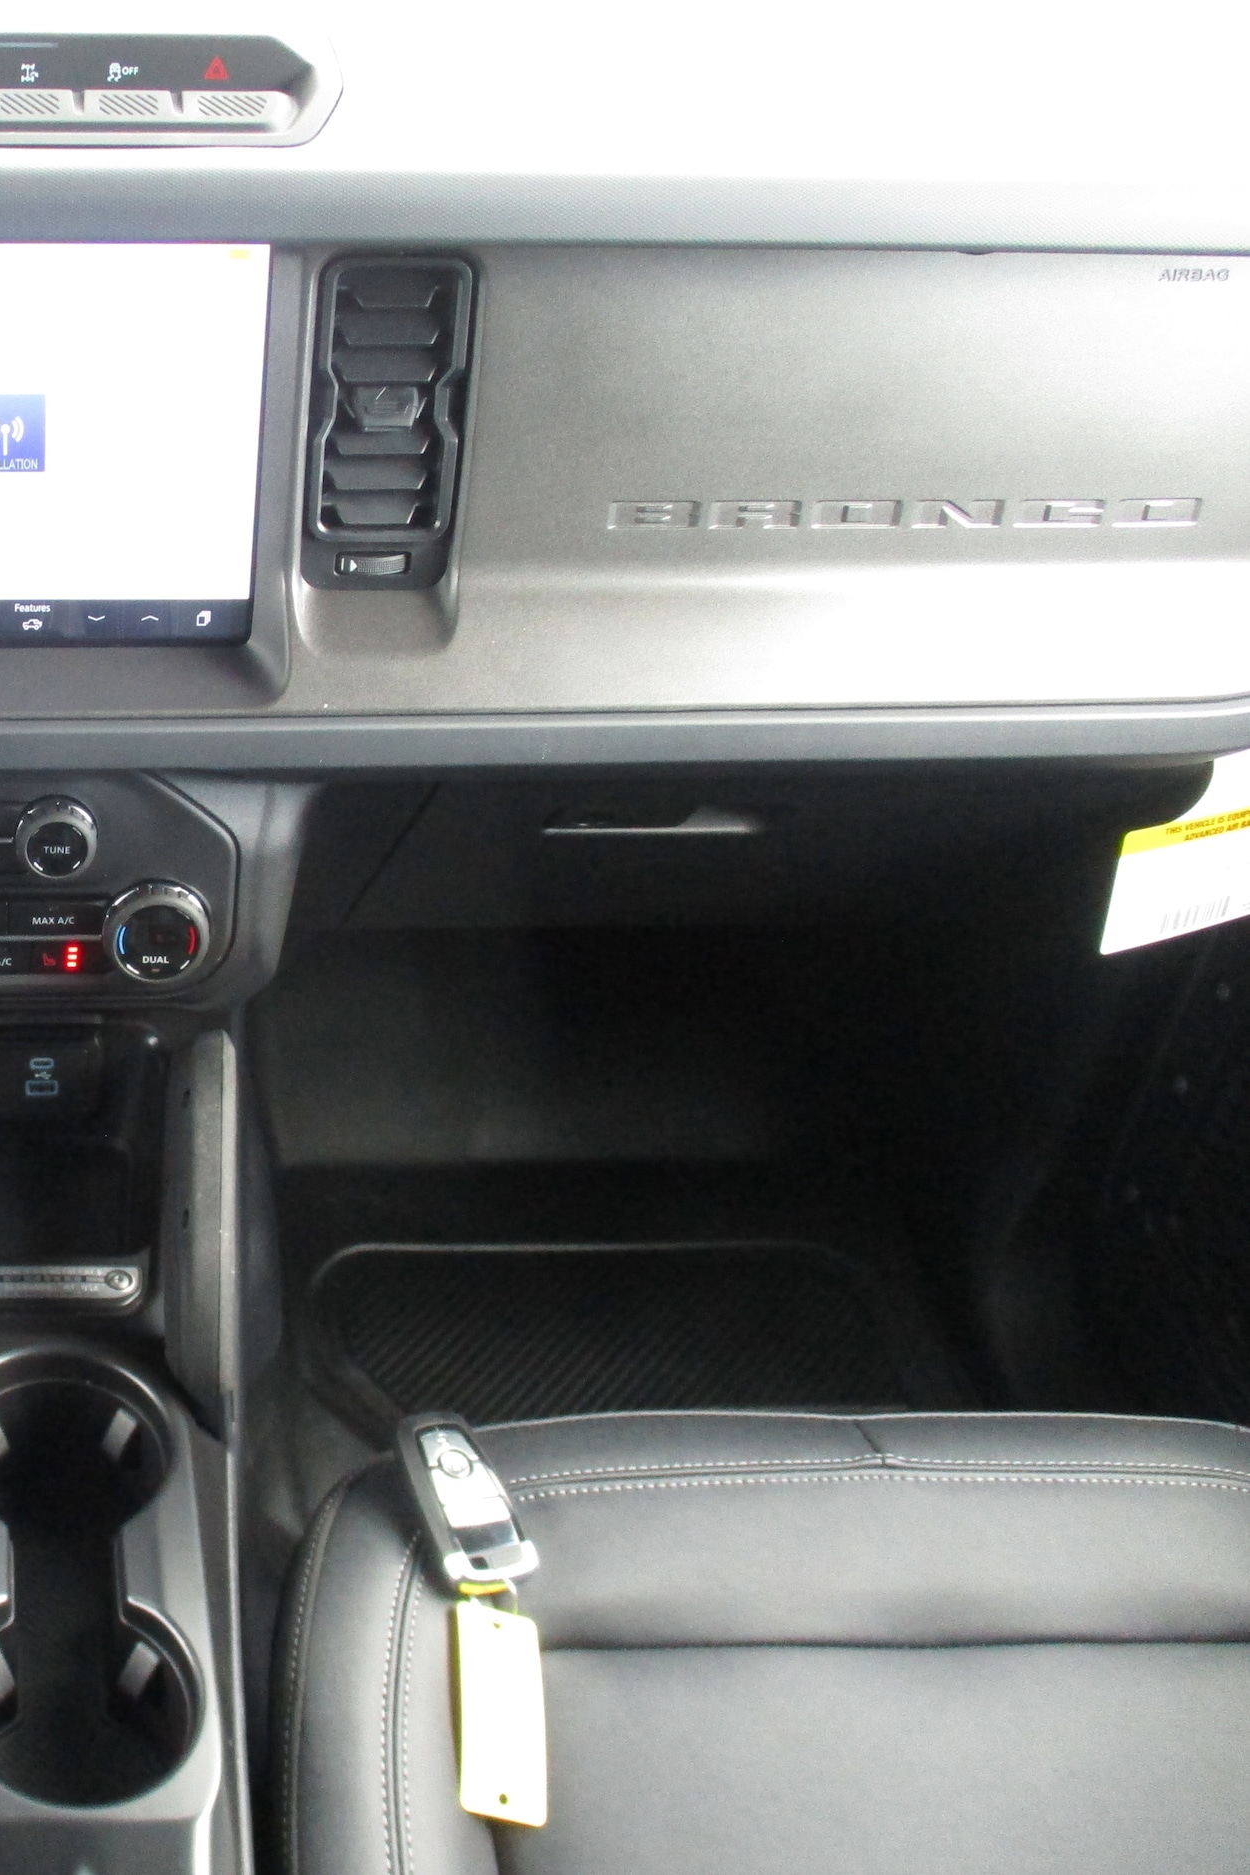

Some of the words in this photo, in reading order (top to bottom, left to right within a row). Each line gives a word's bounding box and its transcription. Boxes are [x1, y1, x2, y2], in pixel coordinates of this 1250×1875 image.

[122, 66, 139, 75] OFF
[1158, 268, 1230, 282] AIRBAG
[14, 603, 51, 613] Features
[1165, 825, 1183, 836] THIS
[1184, 817, 1217, 831] VEHICLE
[1217, 815, 1226, 824] IS
[1183, 826, 1225, 841] ADVANCED
[1226, 822, 1240, 832] AIR
[43, 846, 71, 854] TUNE
[32, 916, 55, 925] MAX
[57, 916, 75, 925] A/C
[142, 955, 170, 964] DUAL
